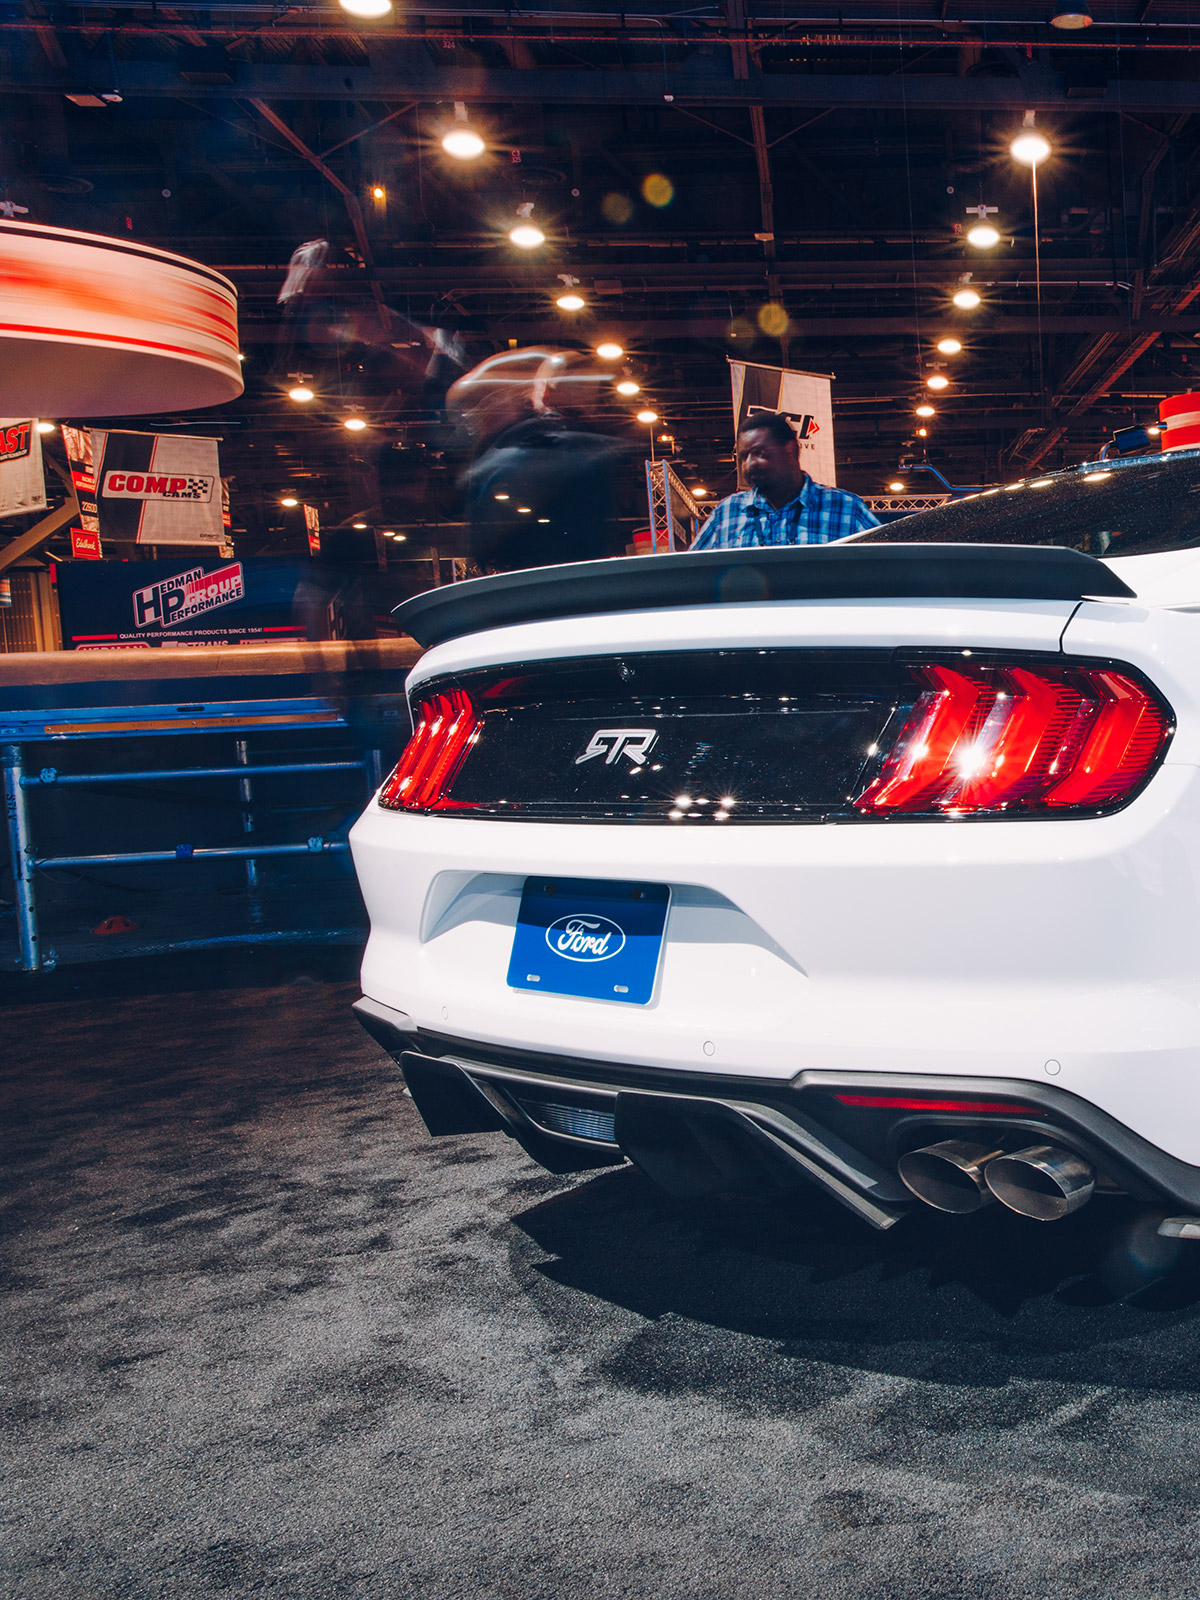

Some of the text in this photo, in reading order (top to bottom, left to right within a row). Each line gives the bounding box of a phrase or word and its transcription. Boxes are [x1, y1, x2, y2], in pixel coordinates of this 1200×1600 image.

[108, 474, 188, 494] COMP
[162, 491, 202, 499] CAMS
[184, 574, 242, 607] GROUP
[146, 630, 193, 638] PERFORMANCE
[194, 628, 228, 636] PRODUCTS
[557, 919, 612, 956] Ford
